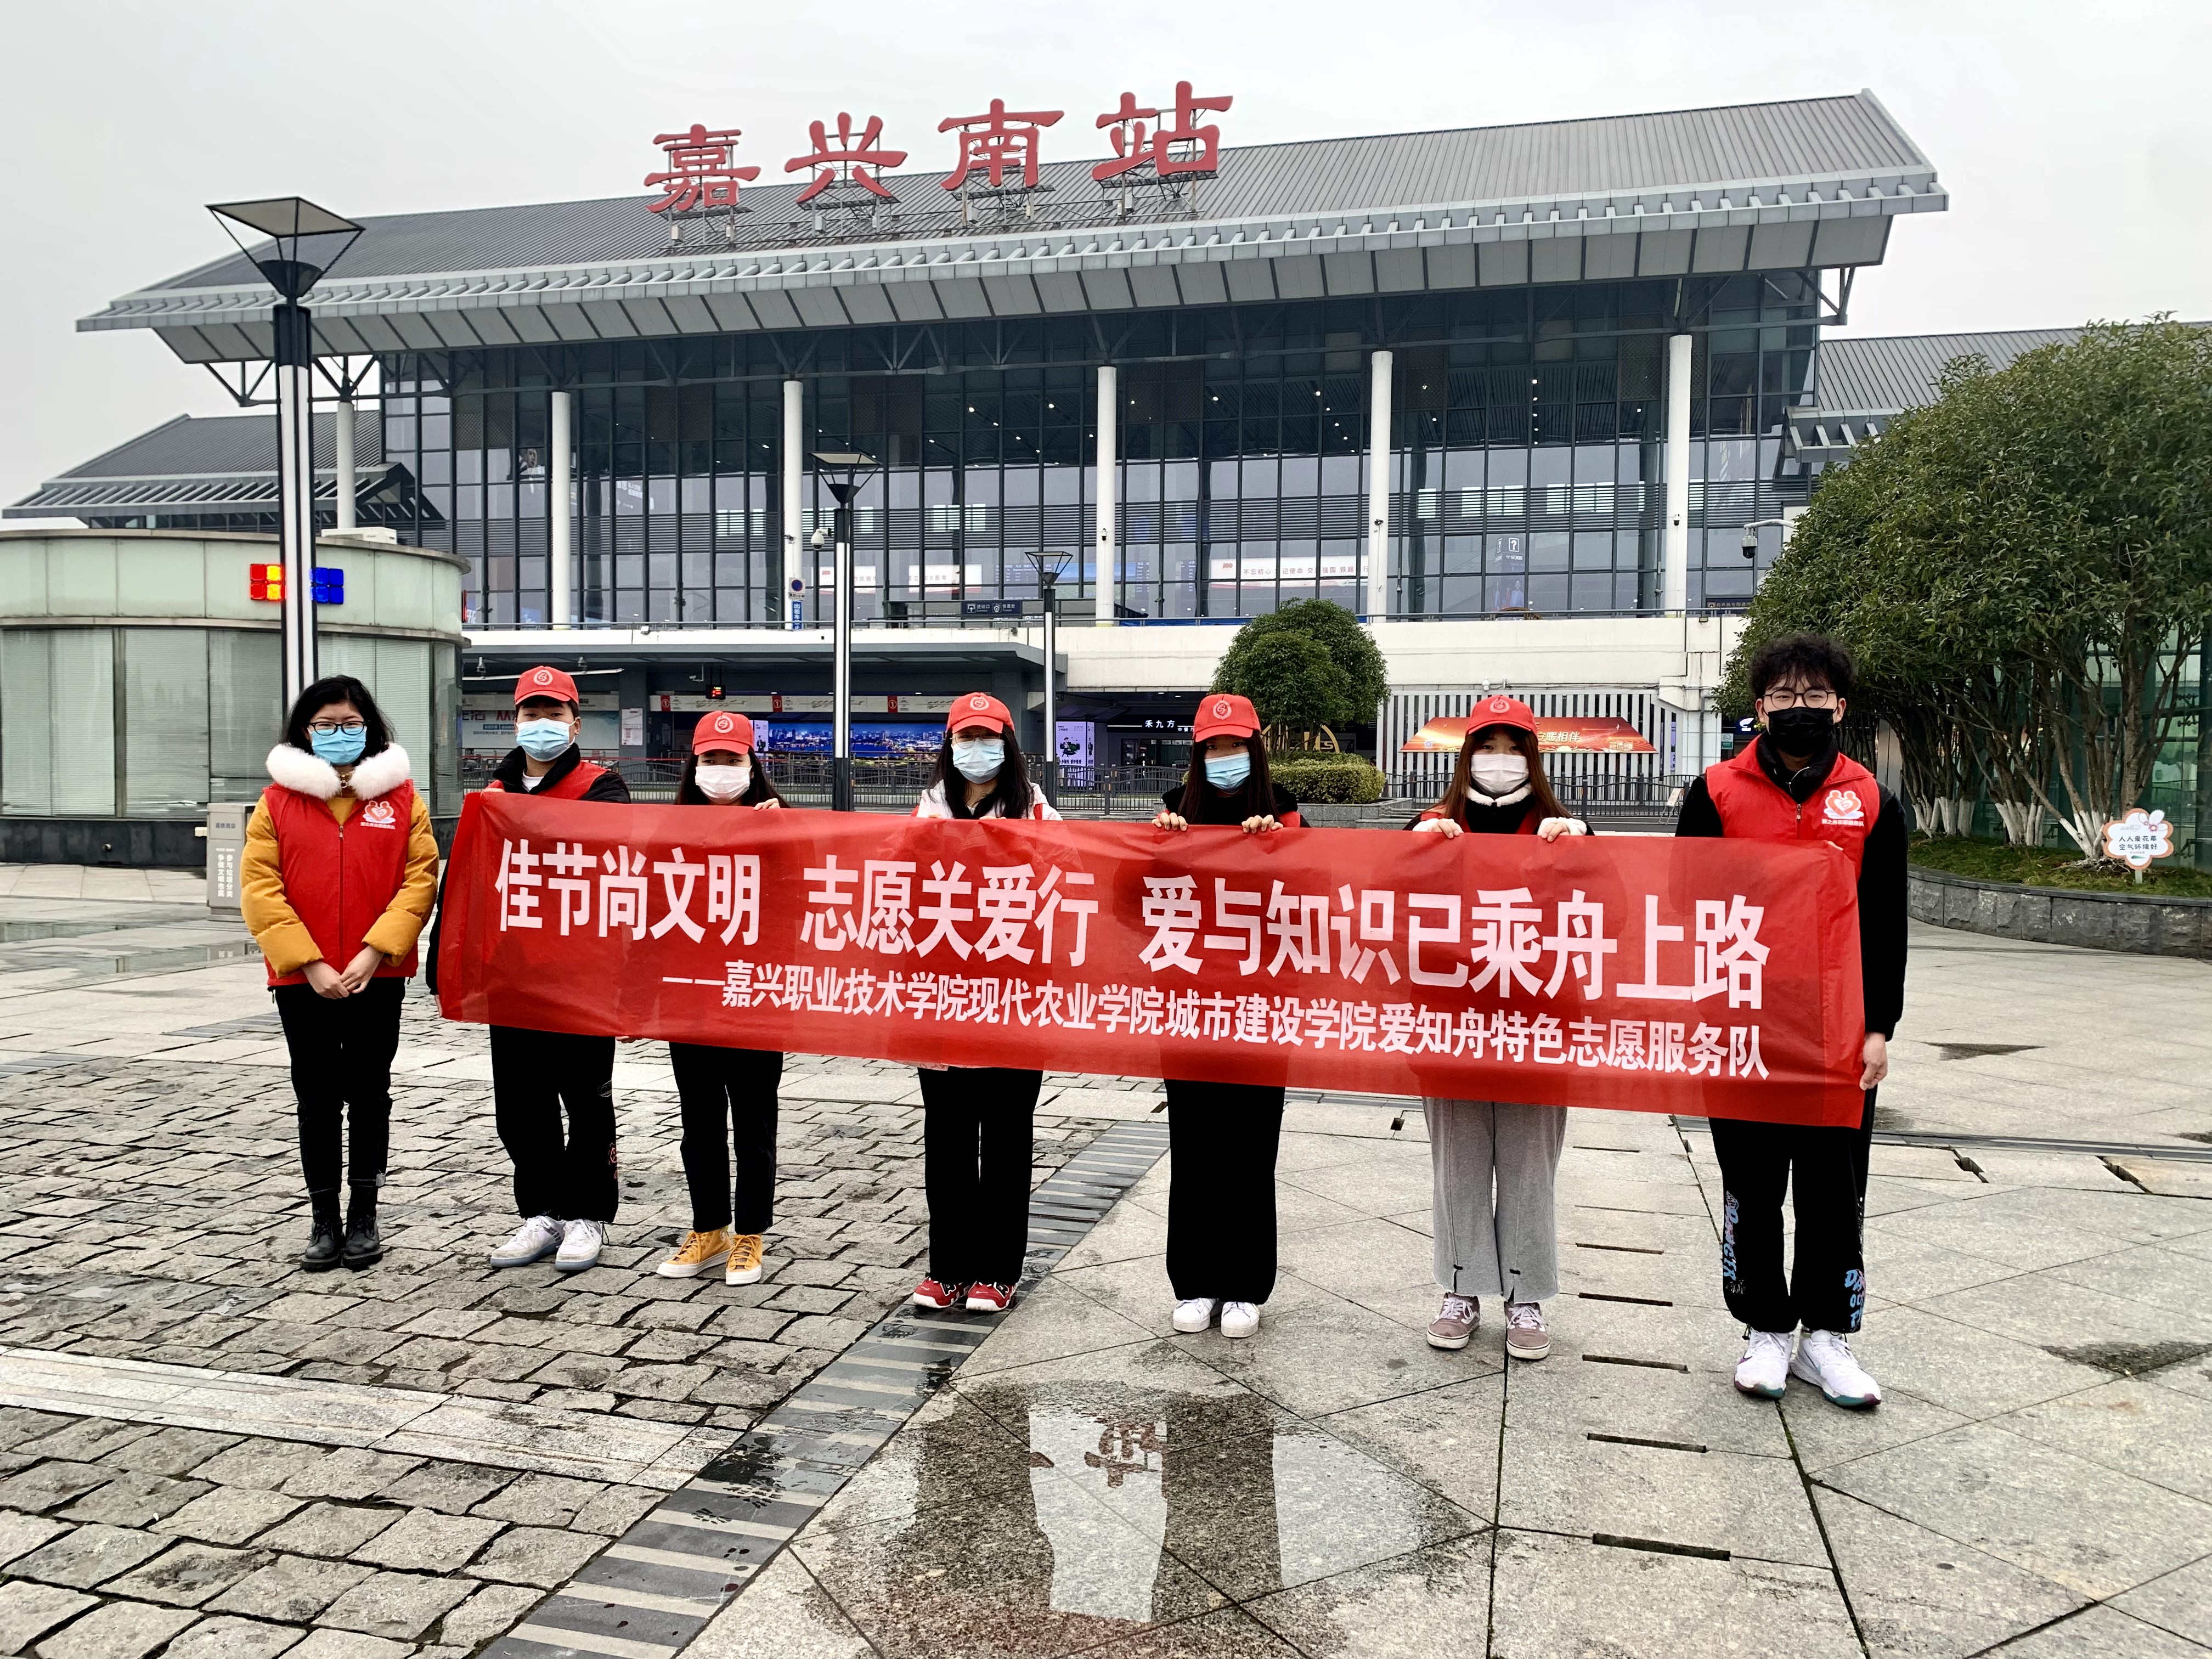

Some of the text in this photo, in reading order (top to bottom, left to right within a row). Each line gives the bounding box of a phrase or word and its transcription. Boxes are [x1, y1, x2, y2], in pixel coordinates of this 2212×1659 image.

[644, 81, 1233, 213] 嘉兴南站
[1145, 720, 1175, 728] 禾九方
[495, 838, 1770, 1009] 佳节尚文明 志愿关爱行 爱与知识已乘舟上路
